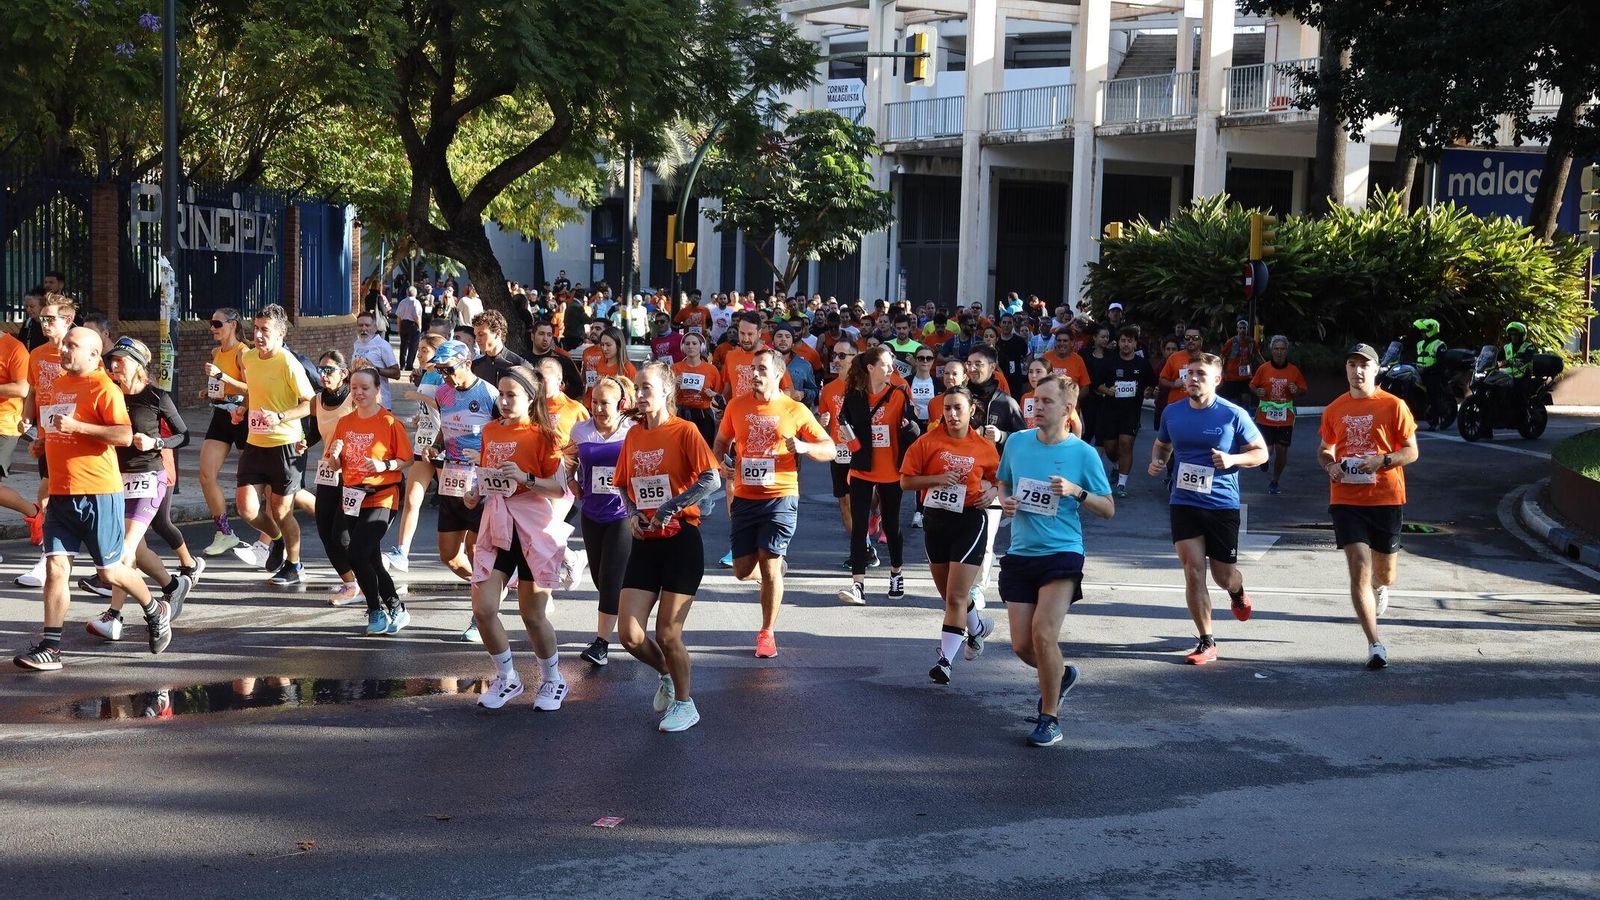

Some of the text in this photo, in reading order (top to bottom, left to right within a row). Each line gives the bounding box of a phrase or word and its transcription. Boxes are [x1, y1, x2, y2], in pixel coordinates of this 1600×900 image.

[683, 377, 700, 385] 833
[417, 436, 432, 445] 875
[320, 469, 334, 479] 437
[744, 467, 768, 478] 207
[444, 478, 466, 488] 596
[484, 477, 511, 489] 101
[1182, 472, 1206, 485] 361
[124, 480, 150, 491] 175
[639, 486, 665, 499] 856
[931, 490, 958, 504] 368
[1022, 489, 1051, 505] 798
